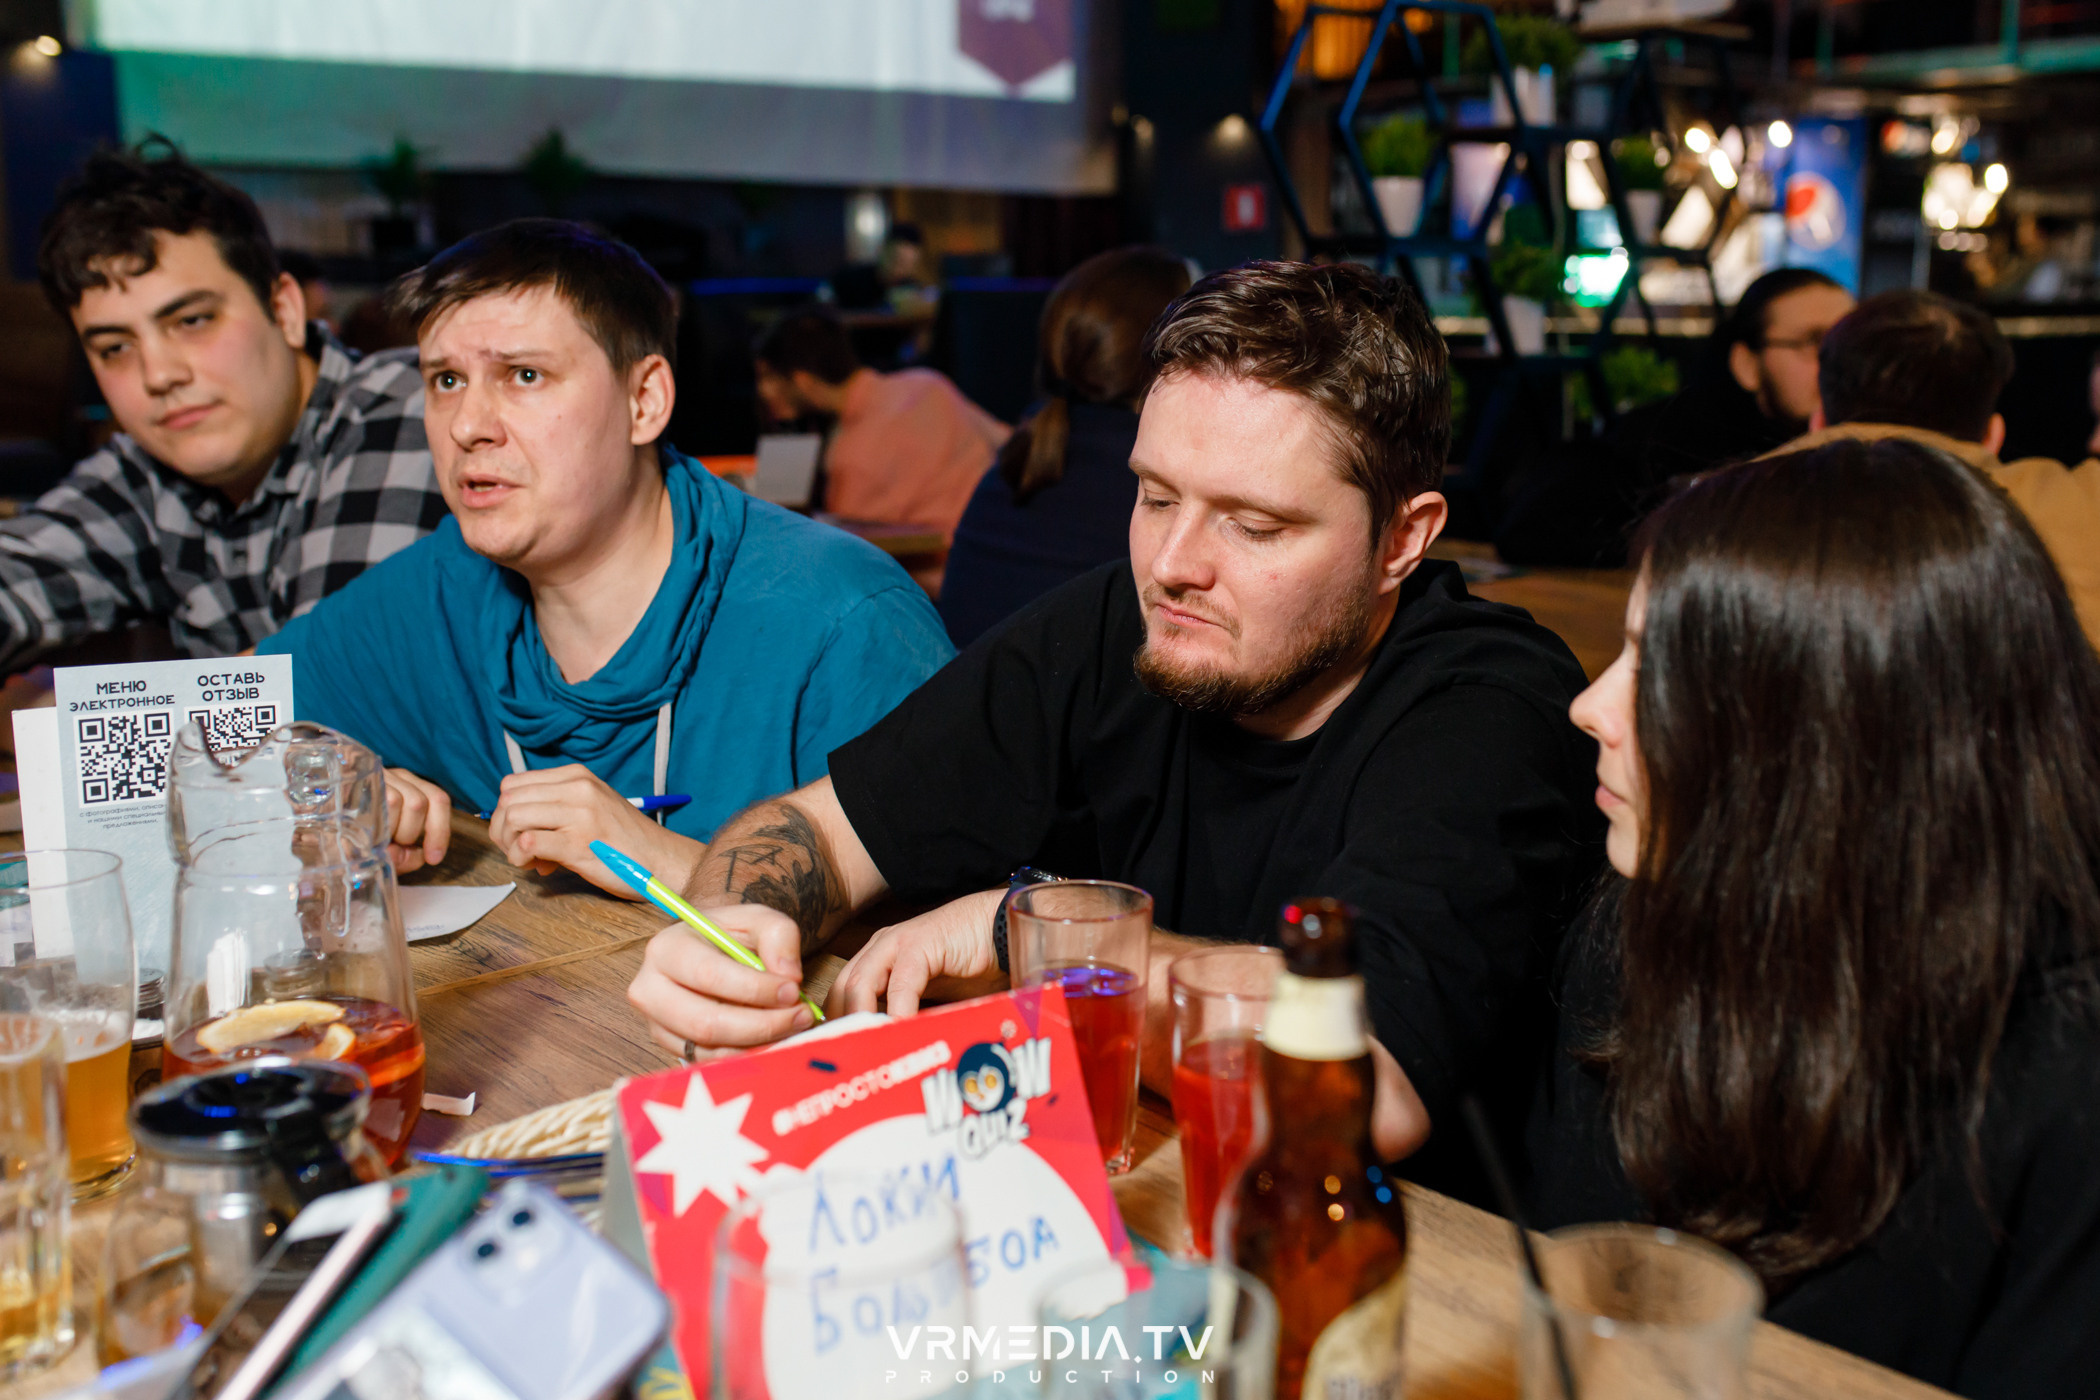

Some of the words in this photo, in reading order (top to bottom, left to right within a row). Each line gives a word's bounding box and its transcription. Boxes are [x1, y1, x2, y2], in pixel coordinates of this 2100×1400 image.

[197, 671, 265, 687] ОСТАВЬ
[96, 680, 147, 695] МЕНЮ
[202, 687, 260, 702] ОТЗЫВ
[69, 694, 175, 712] ЭЛЕКТРОННОЕ
[957, 1097, 1030, 1160] QUIZ
